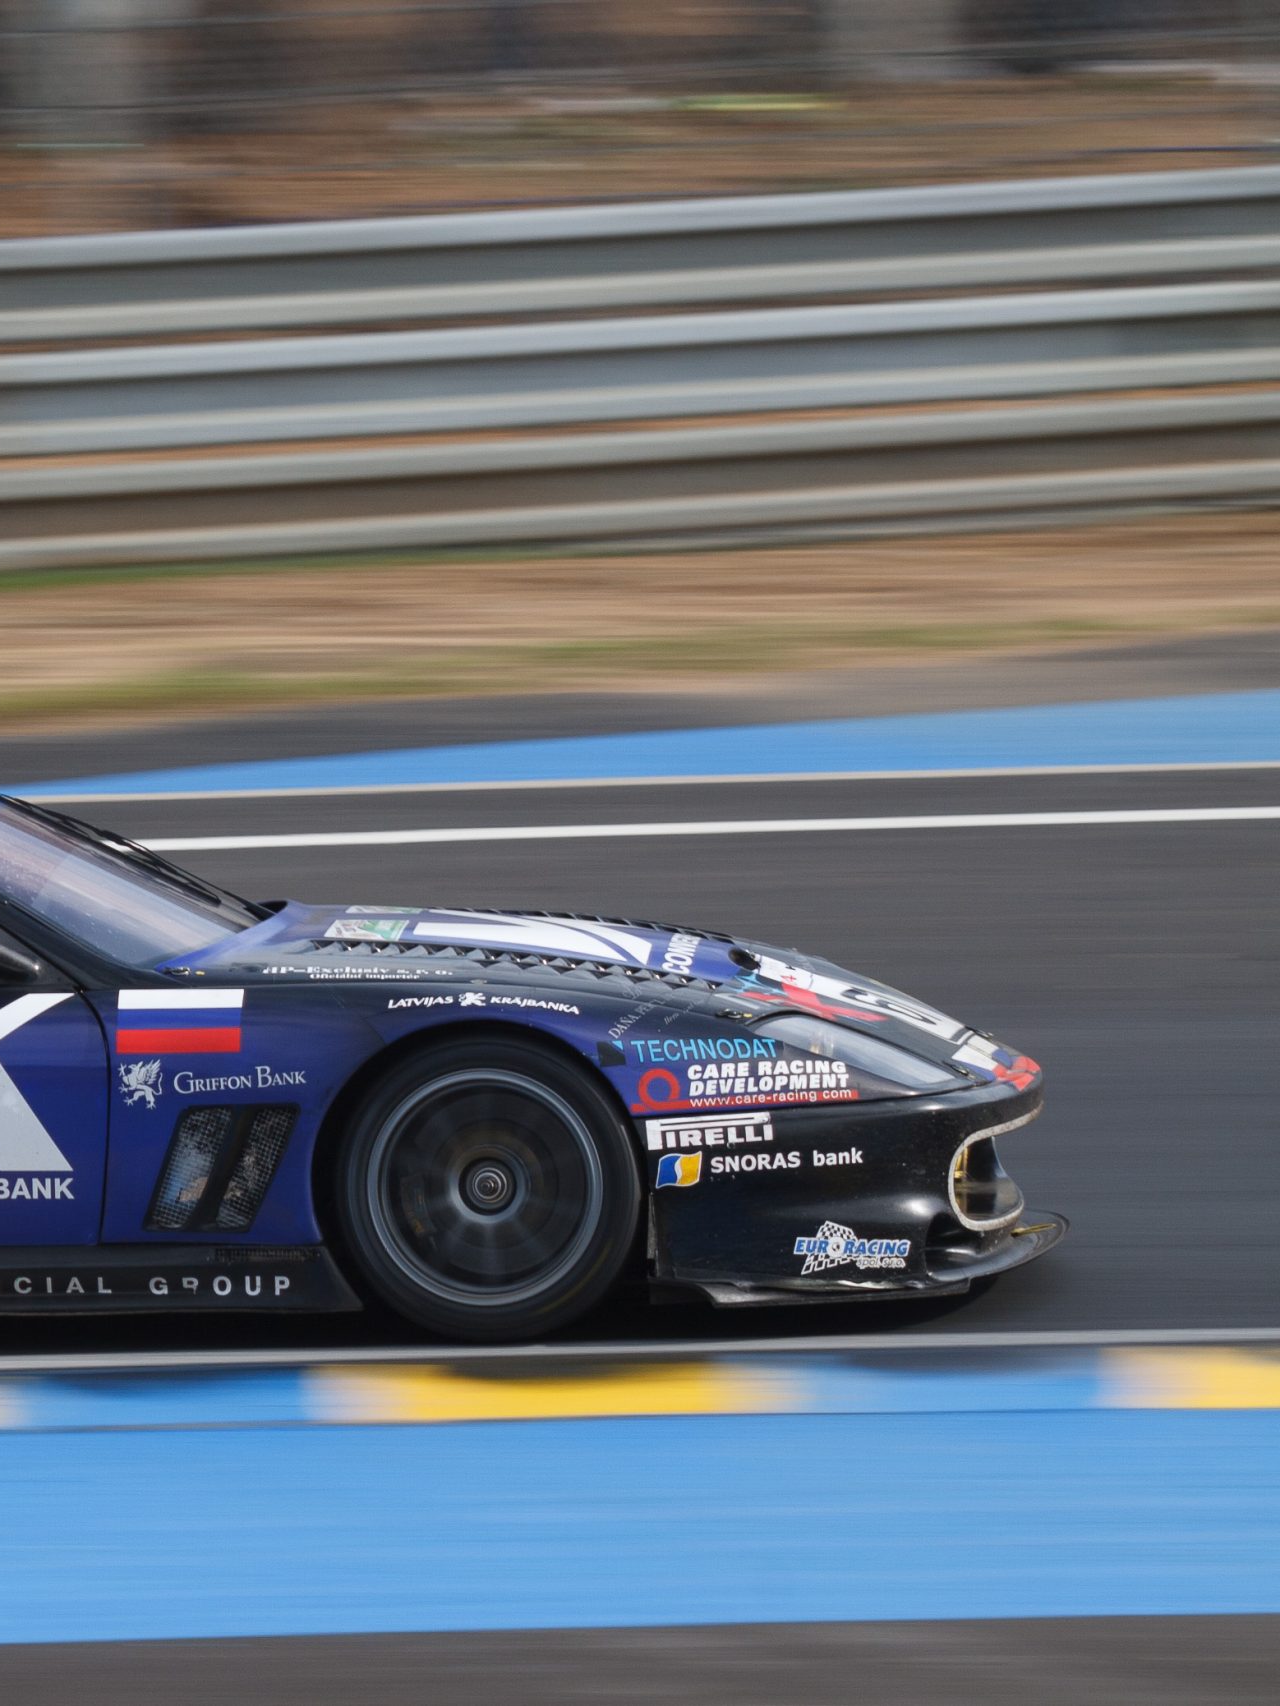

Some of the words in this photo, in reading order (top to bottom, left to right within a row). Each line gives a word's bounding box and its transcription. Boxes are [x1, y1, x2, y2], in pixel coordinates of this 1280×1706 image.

[387, 995, 454, 1010] LATVIJAS
[630, 1037, 778, 1064] TECHNODAT
[687, 1062, 750, 1080] CARE
[758, 1060, 847, 1077] RACING
[689, 1073, 850, 1097] DEVELOPMENT
[689, 1088, 853, 1108] www.care-racingcom
[645, 1111, 774, 1150] PIRELLI
[710, 1150, 801, 1173] SNORAS
[812, 1147, 864, 1167] bank
[148, 1275, 291, 1297] GROUP
